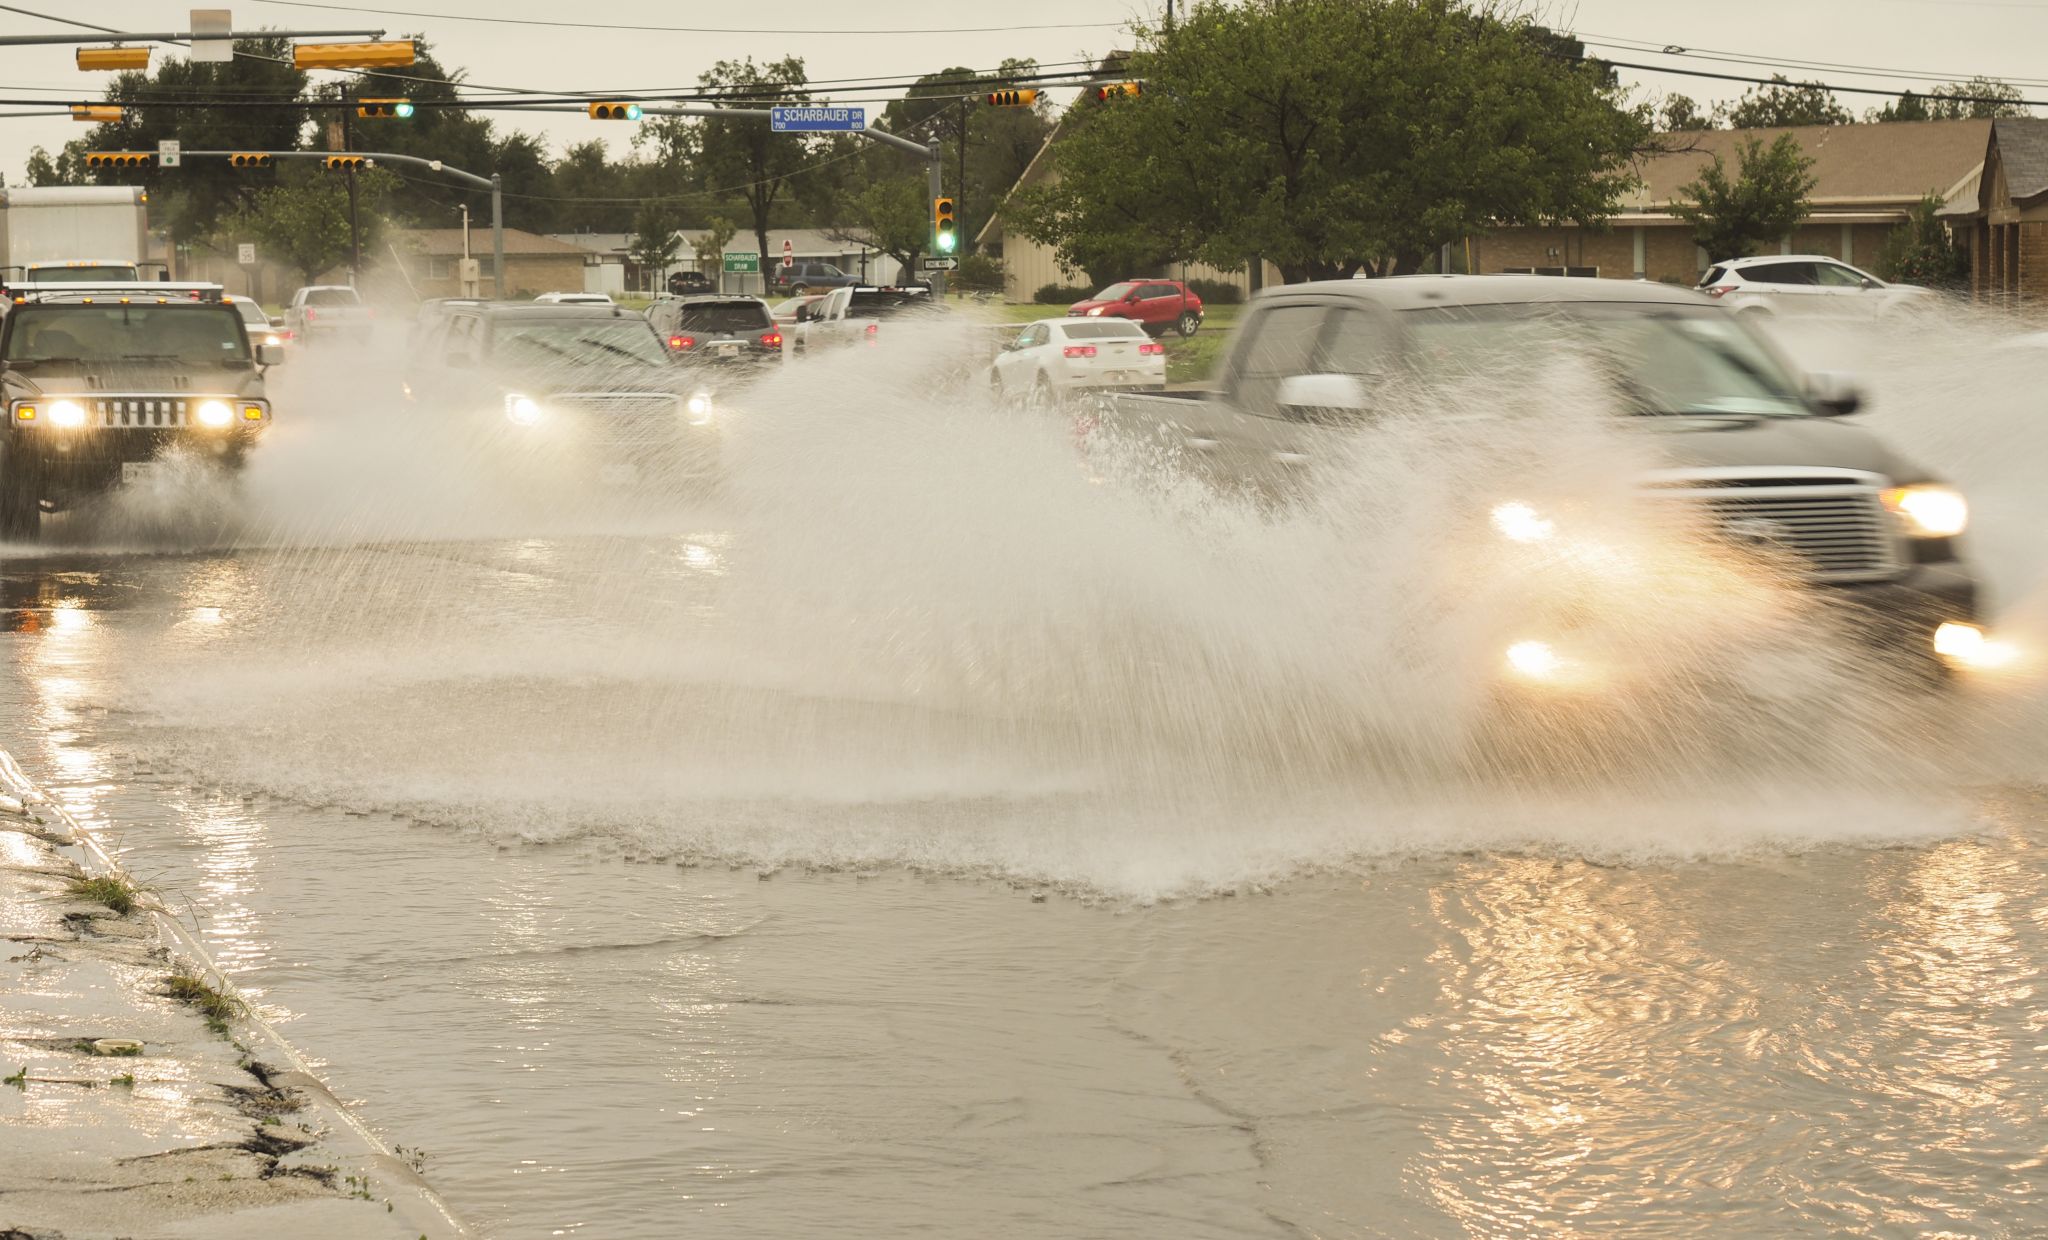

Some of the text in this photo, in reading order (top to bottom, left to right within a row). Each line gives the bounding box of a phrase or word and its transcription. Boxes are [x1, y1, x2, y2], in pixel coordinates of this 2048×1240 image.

[774, 109, 863, 121] W SCHARBAUER DR
